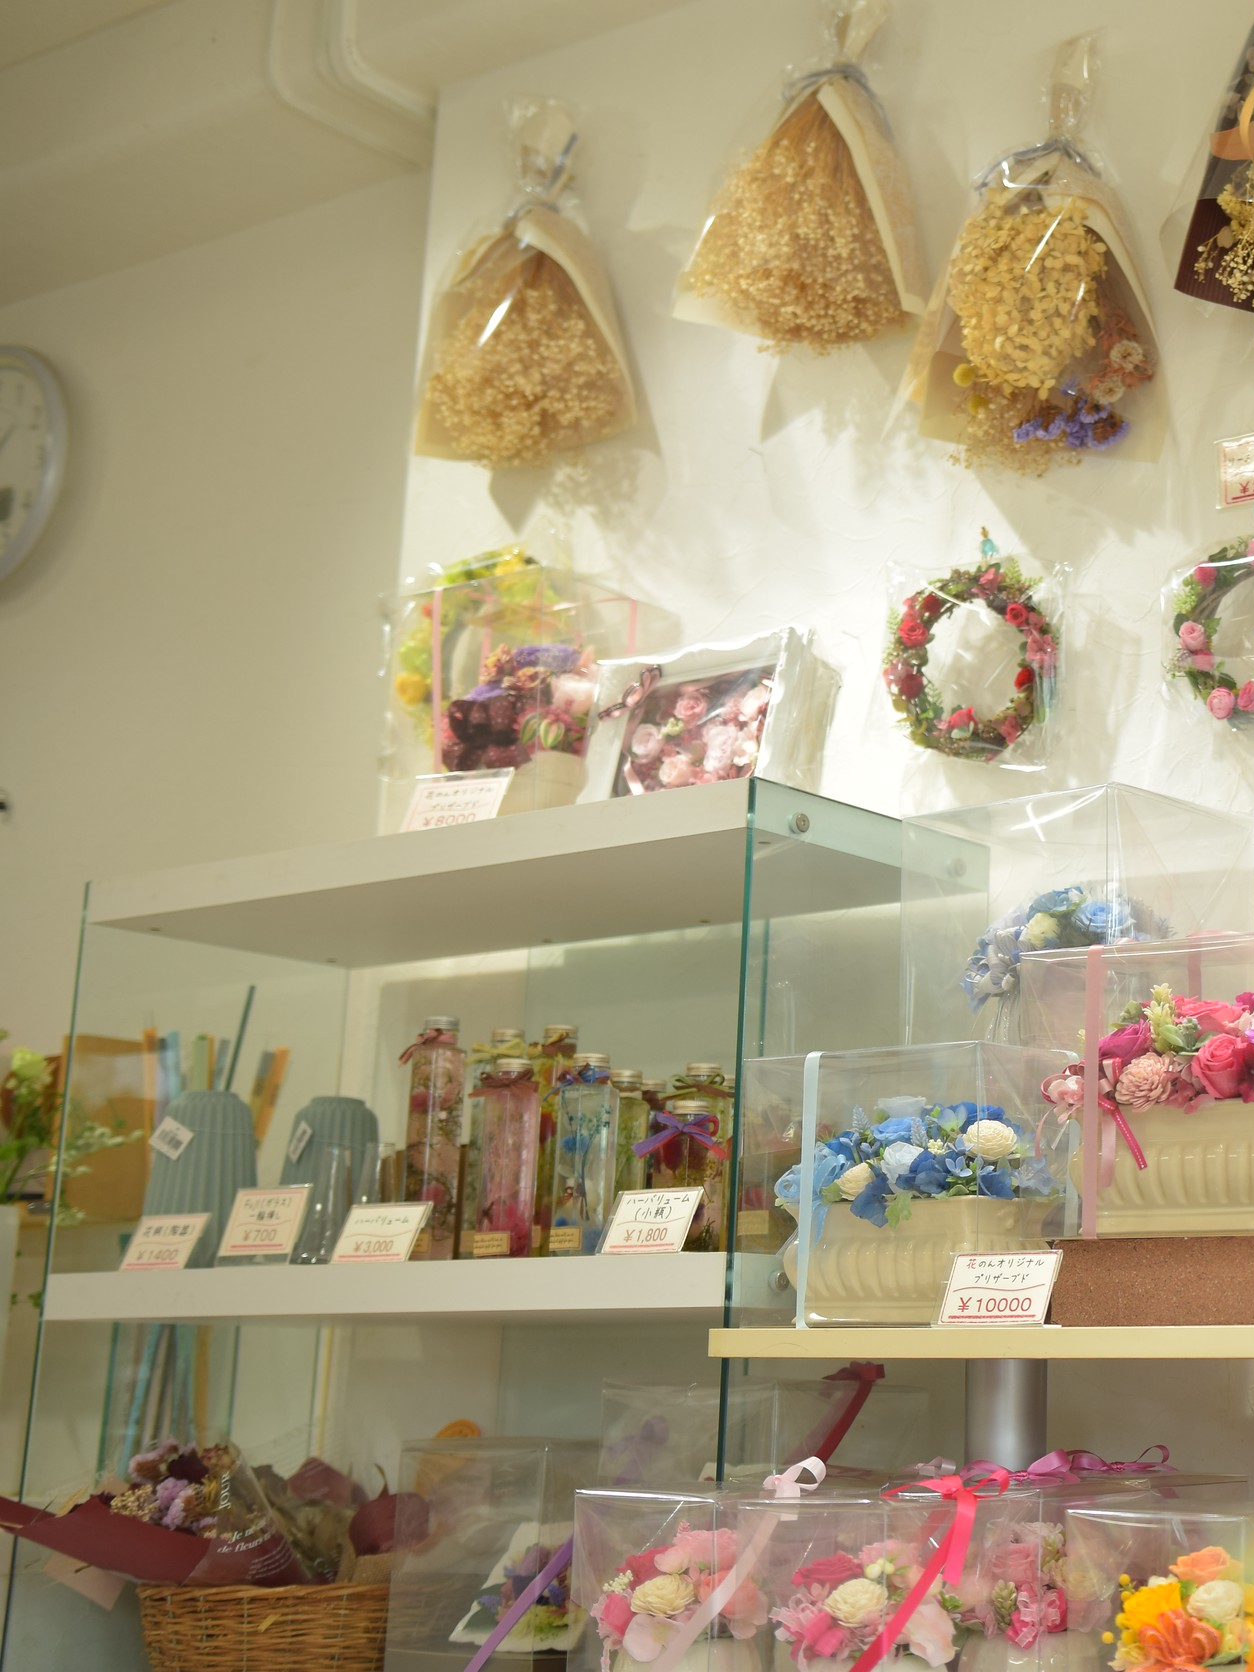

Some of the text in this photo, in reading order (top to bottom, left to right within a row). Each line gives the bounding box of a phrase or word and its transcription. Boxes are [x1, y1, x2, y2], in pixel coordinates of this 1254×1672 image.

[627, 1194, 691, 1206] ハーバリューム
[243, 1229, 277, 1242] ¥700
[624, 1227, 668, 1243] ¥1,800
[353, 1240, 394, 1253] ¥3,000
[966, 1257, 1045, 1269] 花のんオリジナル
[974, 1273, 1030, 1284] プリザーブド
[958, 1297, 1032, 1313] ¥10000
